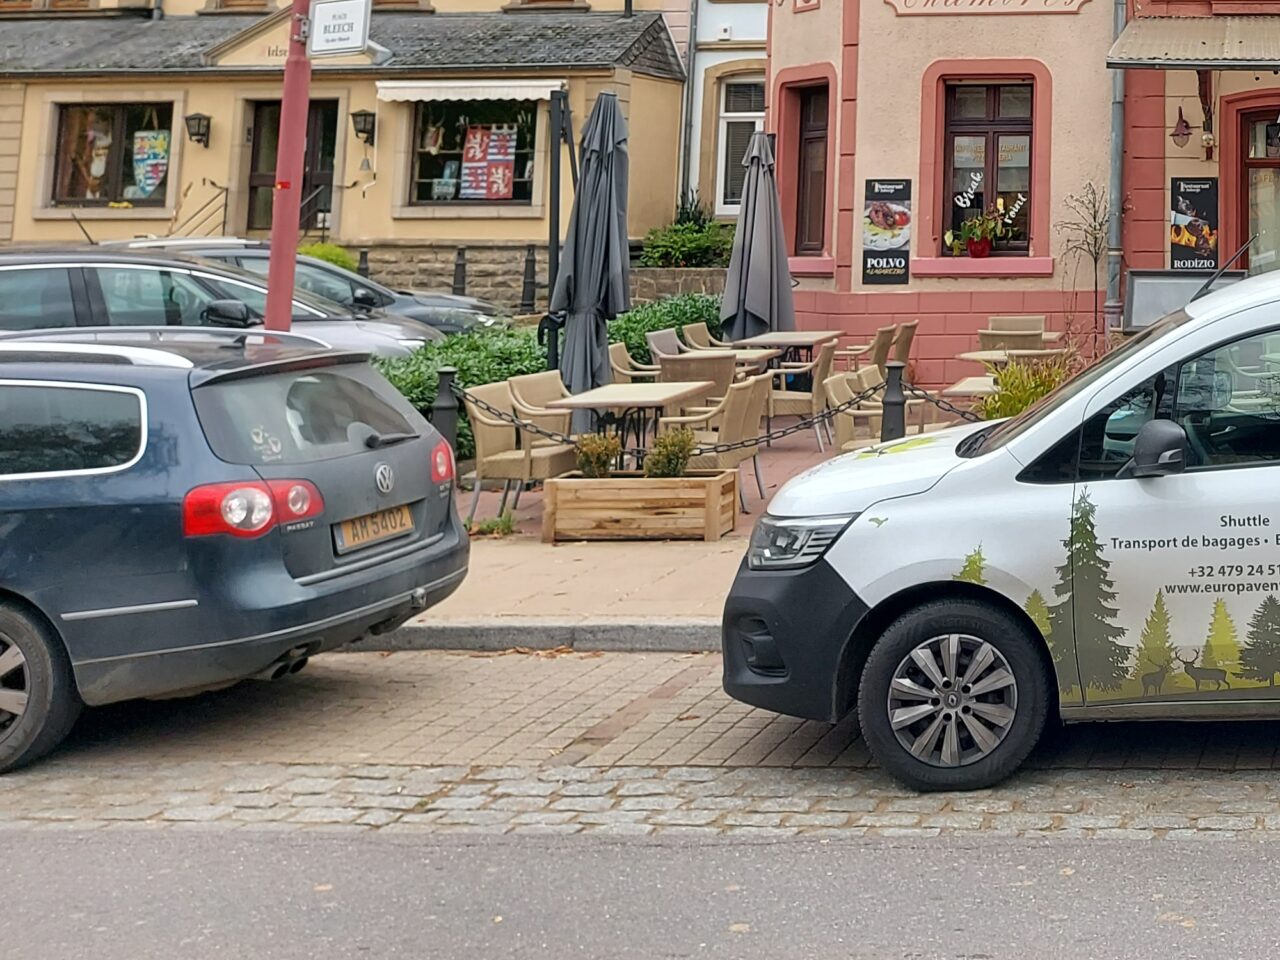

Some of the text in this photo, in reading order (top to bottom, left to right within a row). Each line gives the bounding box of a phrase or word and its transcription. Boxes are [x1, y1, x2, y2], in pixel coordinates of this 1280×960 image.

[323, 22, 354, 35] BLEECH
[954, 171, 983, 208] Break
[866, 257, 906, 268] POLVO
[1174, 256, 1215, 269] RODÍZIO
[1219, 515, 1270, 527] Shuttle
[1110, 537, 1178, 551] Transport
[1181, 535, 1199, 548] de
[1202, 535, 1261, 550] bagages
[1187, 566, 1215, 578] +32
[1217, 565, 1244, 577] 479
[1246, 565, 1264, 576] 24
